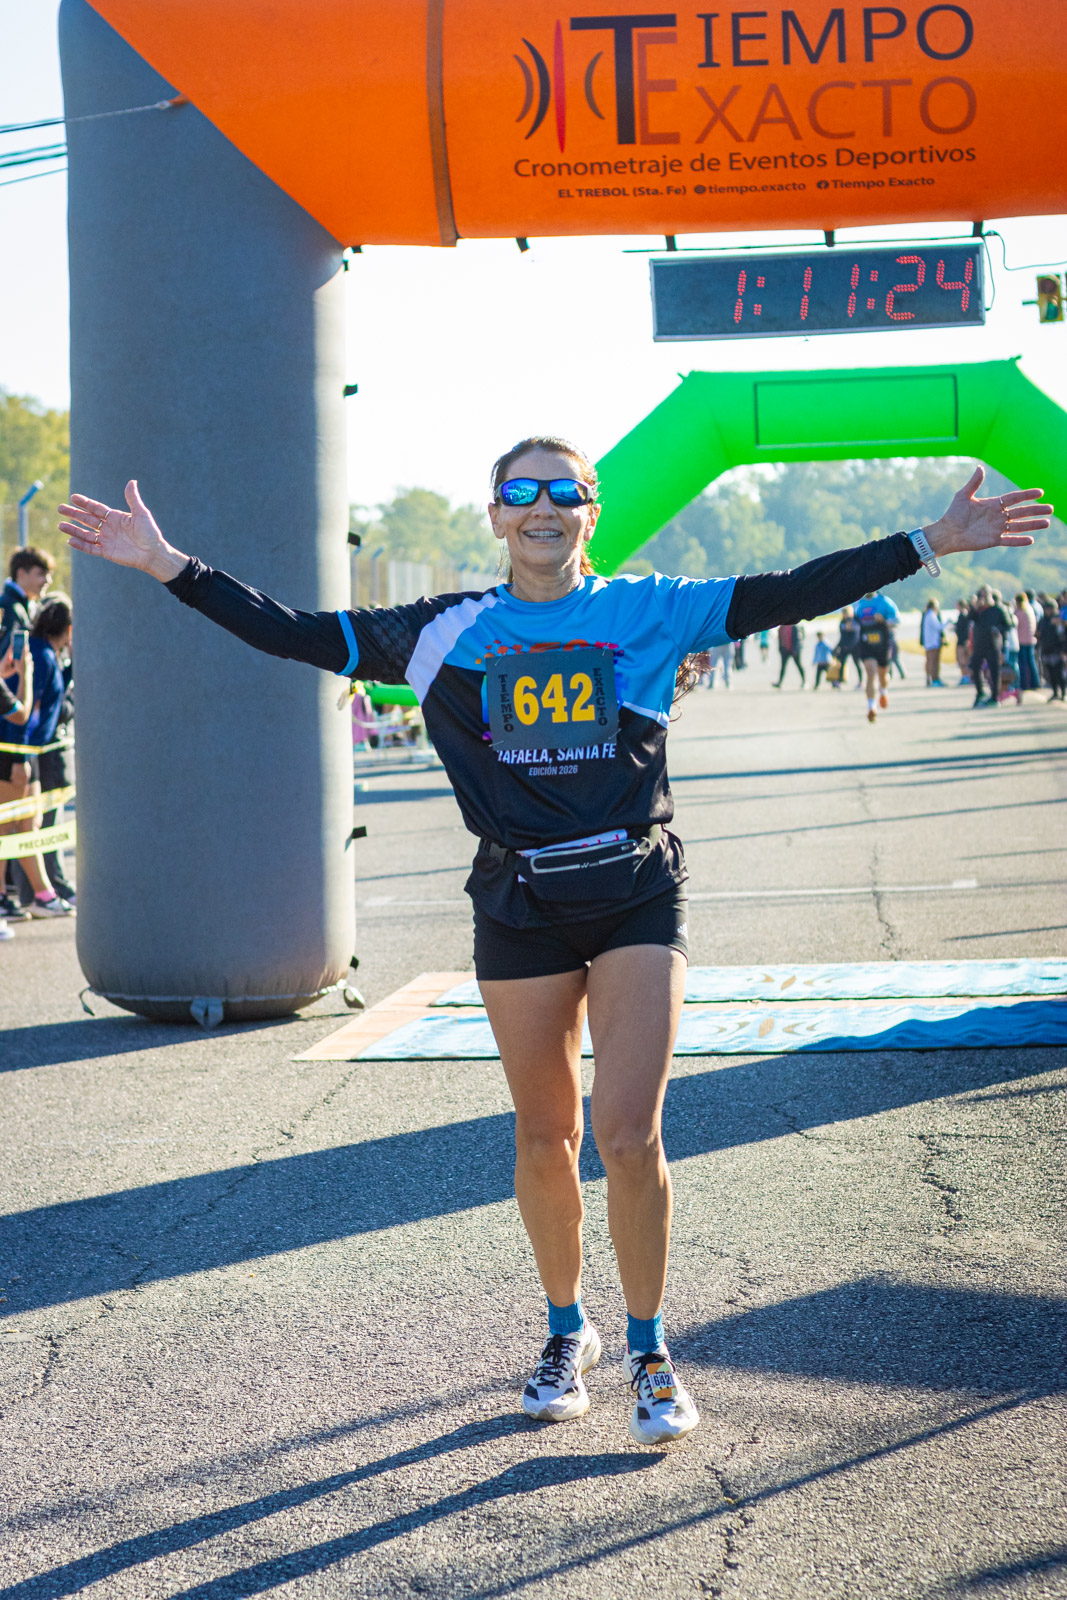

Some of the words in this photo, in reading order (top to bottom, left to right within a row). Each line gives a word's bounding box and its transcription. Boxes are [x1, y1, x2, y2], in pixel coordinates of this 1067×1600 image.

[514, 154, 683, 178] Cronometraje
[690, 153, 721, 172] de
[729, 151, 827, 170] Eventos
[835, 145, 976, 169] Deportivos
[558, 189, 573, 198] EL
[578, 187, 629, 197] TREBOL
[633, 186, 663, 197] (Sta.
[666, 185, 686, 196] Fe)
[709, 181, 806, 195] tiempo.exacto
[831, 178, 885, 190] Tiempo
[889, 176, 935, 188] Exacto
[498, 673, 514, 733] TIEMPO
[513, 672, 596, 726] 642
[592, 667, 608, 727] EXACTO
[602, 743, 616, 759] FE
[529, 765, 557, 776] EDICIÓN
[558, 764, 578, 775] 2026
[653, 1374, 672, 1387] 642
